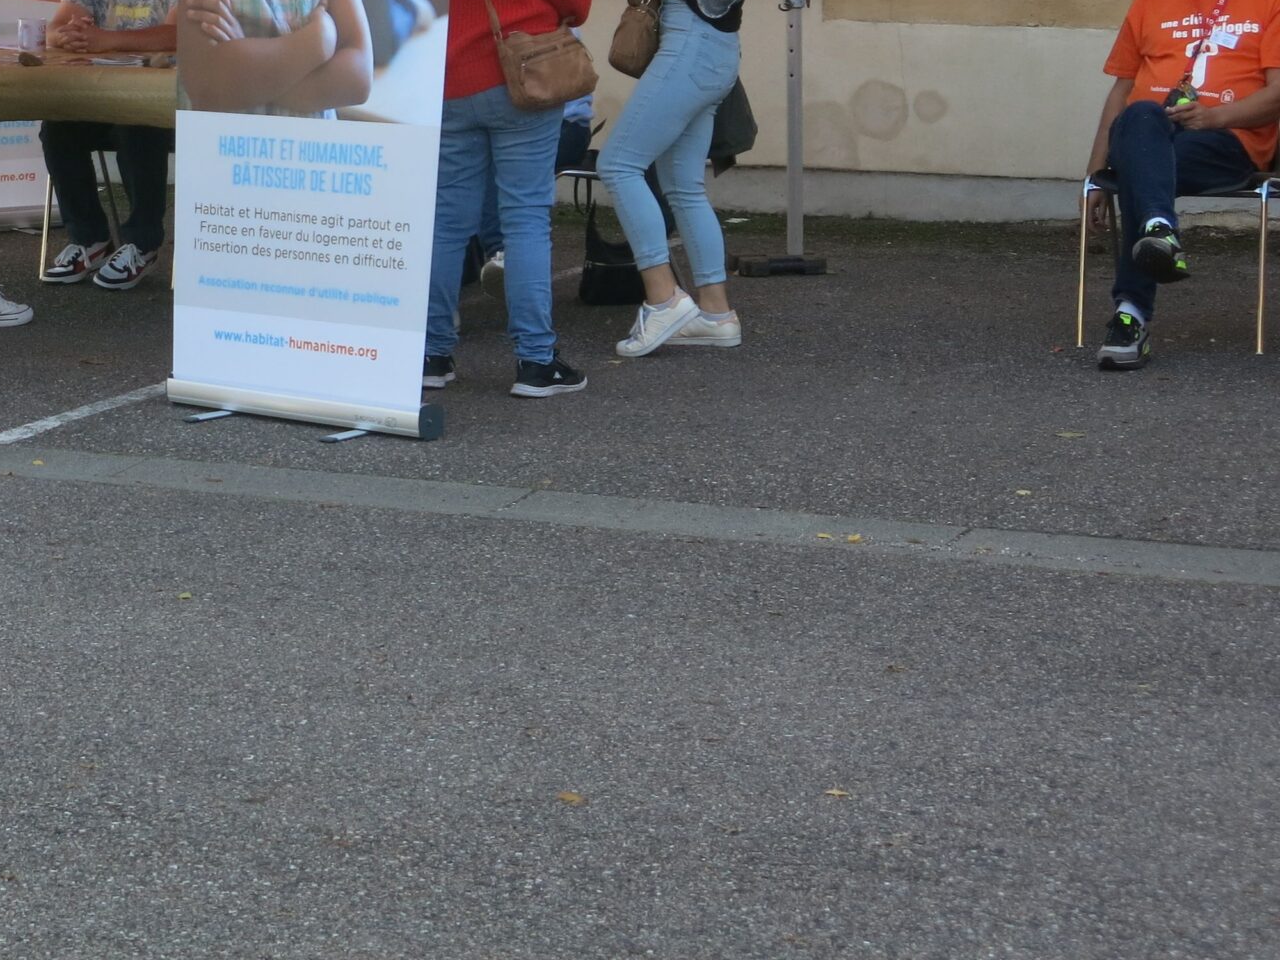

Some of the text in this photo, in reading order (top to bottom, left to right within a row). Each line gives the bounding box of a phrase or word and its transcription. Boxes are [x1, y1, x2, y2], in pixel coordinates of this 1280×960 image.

[1161, 20, 1178, 29] une
[1173, 30, 1188, 38] les
[218, 135, 388, 170] HABITAT ET HUMANISME,
[232, 162, 372, 196] BÂTISSEUR DE LIENS
[194, 202, 410, 233] Habitat et Humanisme agit partout en
[200, 220, 402, 252] France en faveur du logement et de
[194, 238, 408, 272] l'insertion des personnes en difficulté.
[198, 275, 400, 307] Association reconnue d'utilité publique
[214, 329, 378, 360] www.habitat-humanisme.org
